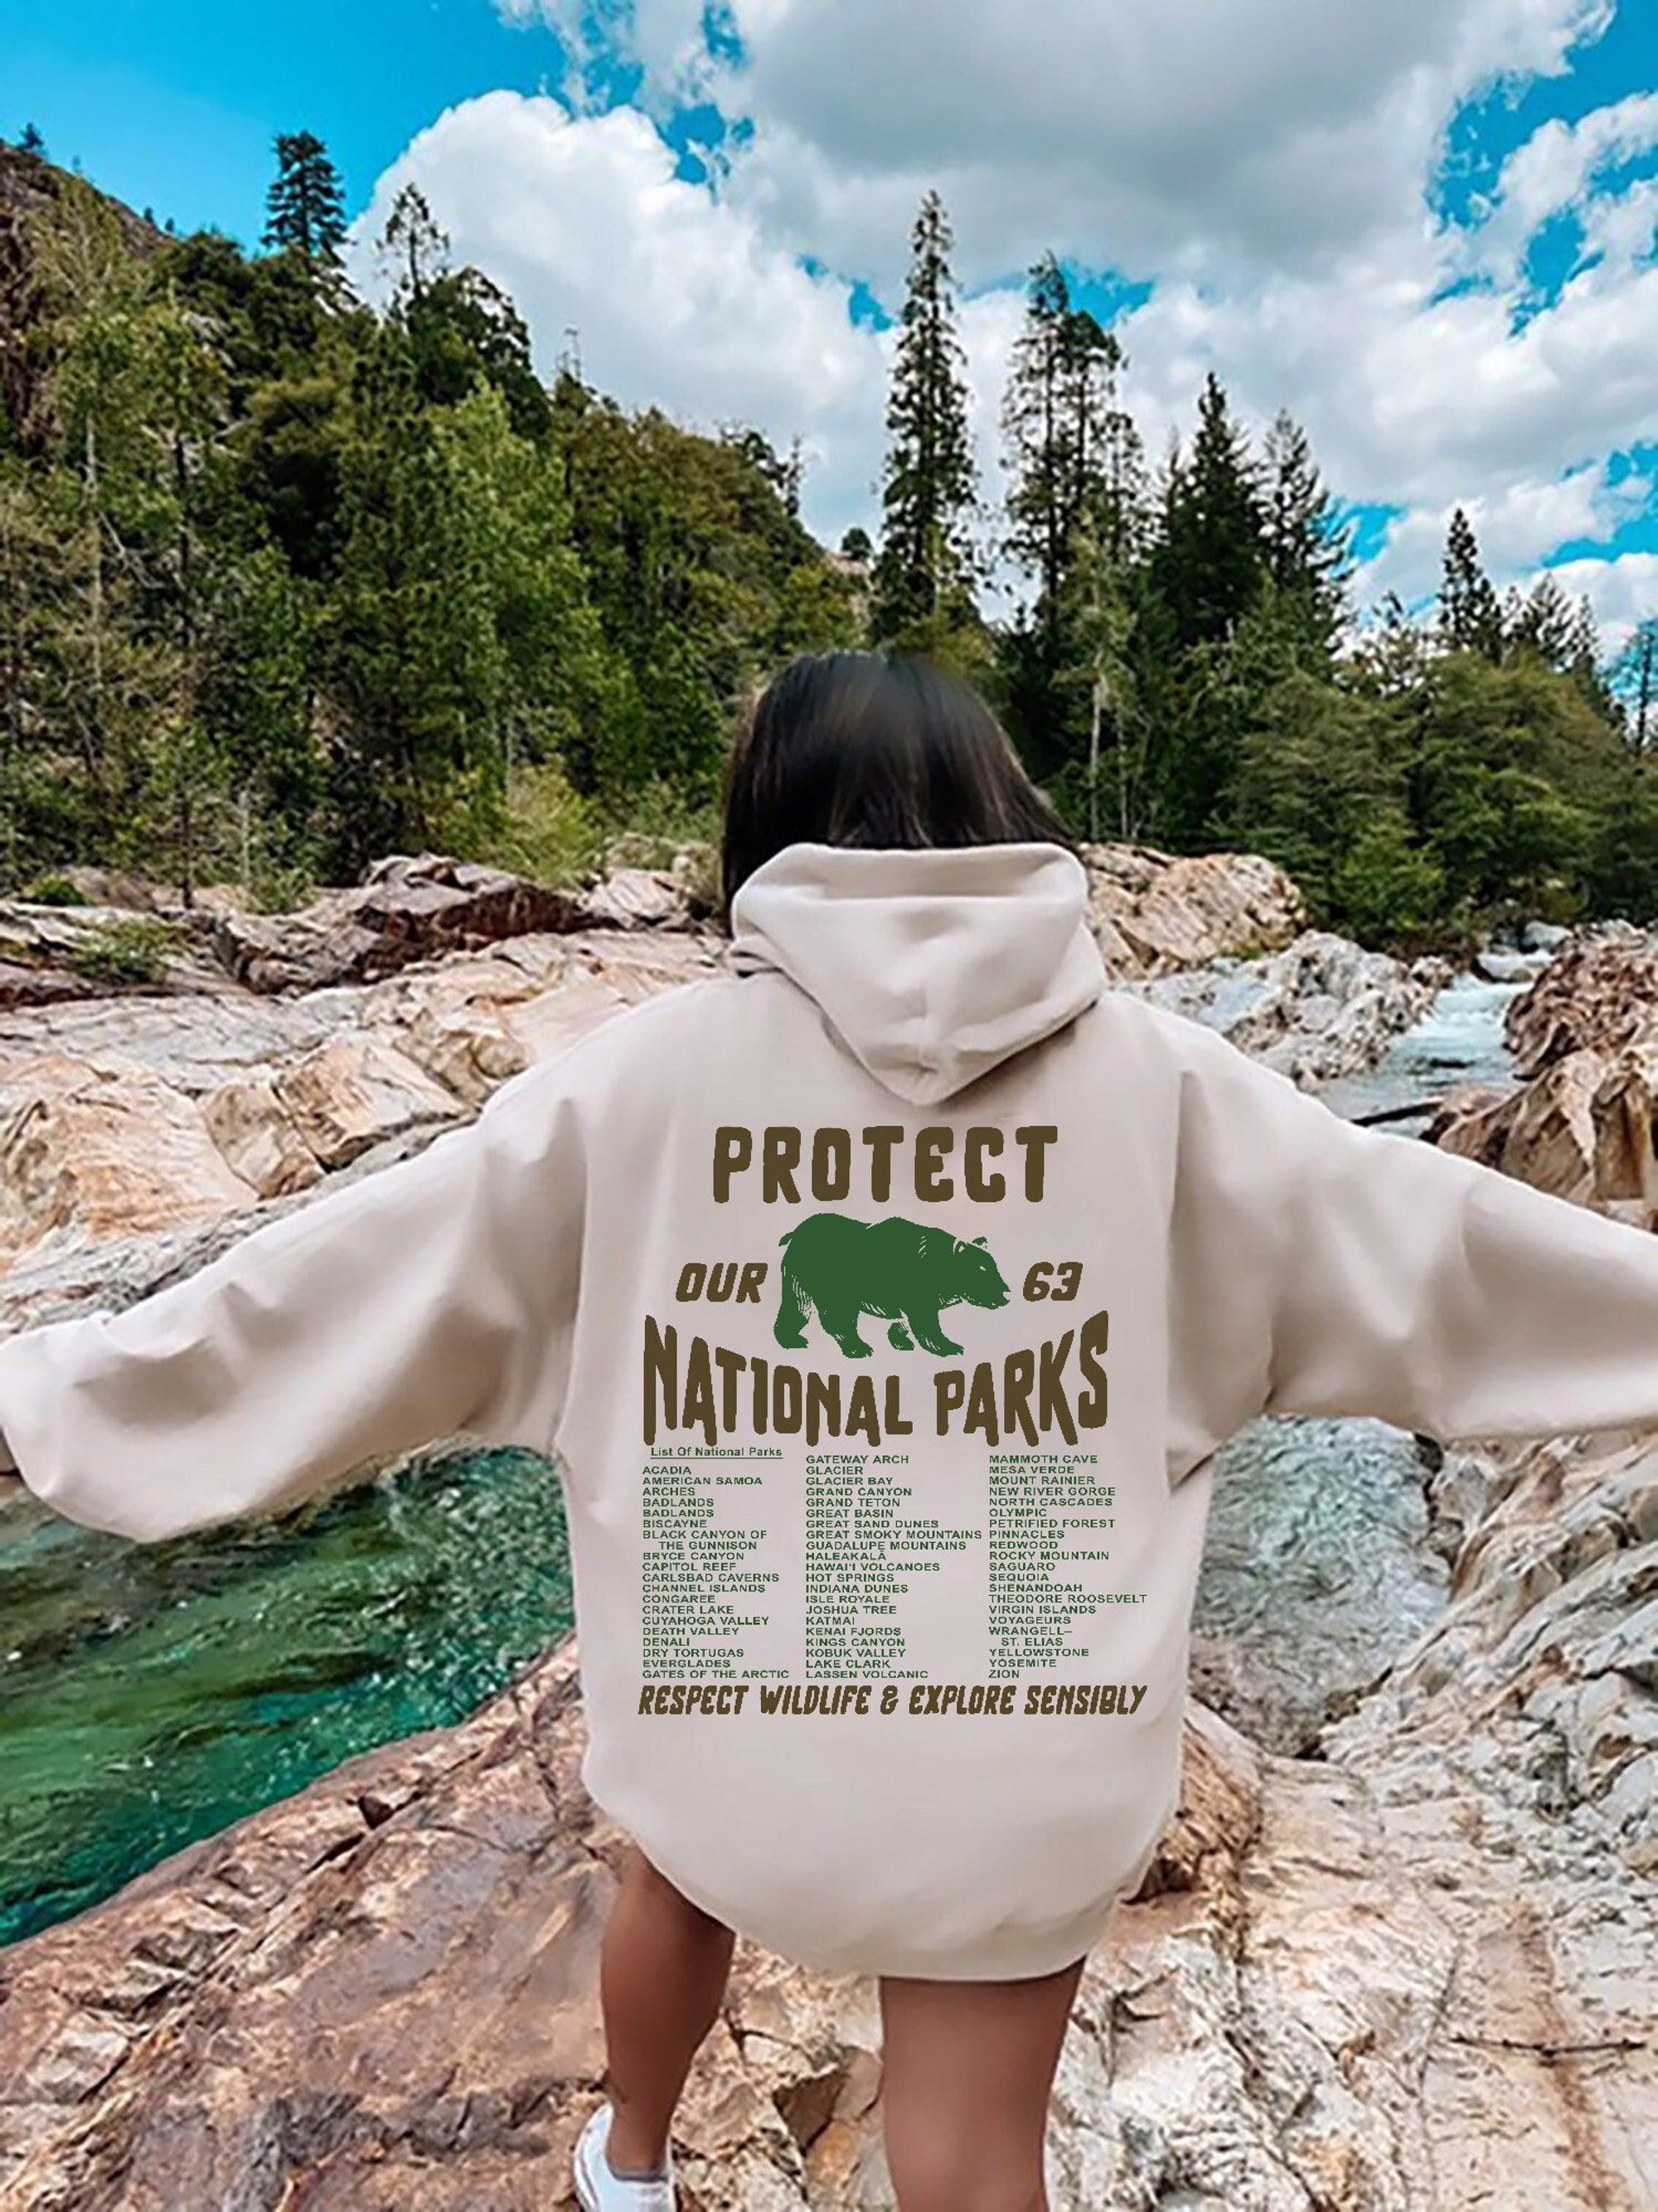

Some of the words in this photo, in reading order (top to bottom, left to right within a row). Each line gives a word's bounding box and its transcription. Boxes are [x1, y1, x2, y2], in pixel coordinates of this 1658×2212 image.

[712, 1125, 1059, 1205] PROTECT
[675, 1262, 768, 1304] OUR
[1022, 1261, 1084, 1302] 63
[643, 1314, 914, 1447] NATIONAL
[933, 1309, 1109, 1448] PARKS
[650, 1447, 674, 1457] List
[677, 1447, 692, 1457] Of
[695, 1447, 744, 1457] National
[749, 1447, 783, 1457] Parks
[805, 1454, 870, 1464] GATEWAY
[871, 1454, 909, 1464] ARCH
[989, 1454, 1059, 1464] MAMMOTH
[1062, 1454, 1098, 1464] CAVE
[642, 1466, 692, 1475] ACADIA
[805, 1465, 864, 1476] GLACIER
[989, 1464, 1026, 1474] MESA
[1030, 1465, 1075, 1474] VERDE
[642, 1476, 711, 1486] AMERICAN
[715, 1476, 763, 1486] SAMOA
[805, 1477, 864, 1487] GLACIER
[867, 1477, 894, 1486] BAY
[989, 1475, 1037, 1486] MOUNT
[1041, 1475, 1096, 1486] RAINIER
[642, 1487, 696, 1496] ARCHES
[805, 1487, 854, 1496] GRAND
[857, 1487, 913, 1496] CANYON
[989, 1487, 1020, 1496] NEW
[1023, 1487, 1064, 1496] RIVER
[1068, 1487, 1116, 1496] GORGE
[642, 1497, 715, 1507] BADLANDS
[805, 1497, 854, 1507] GRAND
[857, 1497, 900, 1507] TETON
[989, 1497, 1035, 1507] NORTH
[1039, 1497, 1113, 1507] CASCADES
[642, 1509, 715, 1518] BADLANDS
[805, 1509, 851, 1519] GREAT
[854, 1509, 894, 1519] BASIN
[989, 1507, 1047, 1517] OLYMPIC
[642, 1519, 708, 1529] BISCAYNE
[805, 1520, 851, 1529] GREAT
[854, 1520, 890, 1529] SAND
[894, 1520, 939, 1529] DUNES
[989, 1519, 1059, 1529] PETRIFIED
[1062, 1519, 1116, 1529] FOREST
[642, 1530, 687, 1540] BLACK
[691, 1530, 745, 1540] CANYON
[750, 1530, 768, 1540] OF
[805, 1530, 851, 1540] GREAT
[854, 1530, 902, 1540] SMOKY
[906, 1530, 982, 1540] MOUNTAINS
[989, 1530, 1065, 1540] PINNACLES
[657, 1540, 685, 1550] THE
[688, 1540, 757, 1550] GUNNISON
[805, 1540, 886, 1550] GUADALUPE
[890, 1540, 967, 1550] MOUNTAINS
[989, 1540, 1059, 1550] REDWOOD
[642, 1551, 686, 1560] BRYCE
[691, 1551, 744, 1560] CANYON
[989, 1550, 1036, 1560] ROCKY
[1040, 1550, 1109, 1560] MOUNTAIN
[642, 1562, 699, 1572] CAPITOL
[702, 1562, 736, 1572] REEF
[860, 1562, 940, 1572] VOLCANOES
[989, 1562, 1056, 1572] SAGUARO
[642, 1573, 714, 1583] CARLSBAD
[718, 1573, 780, 1583] CAVERNS
[805, 1573, 832, 1583] HOT
[836, 1573, 894, 1583] SPRINGS
[988, 1573, 1050, 1583] SEQUOIA
[642, 1584, 705, 1594] CHANNEL
[709, 1584, 766, 1594] ISLANDS
[805, 1584, 861, 1594] INDIANA
[864, 1584, 909, 1594] DUNES
[989, 1583, 1083, 1593] SHENANDOAH
[642, 1594, 716, 1603] CONGAREE
[805, 1595, 835, 1603] ISLE
[838, 1595, 890, 1603] ROYALE
[988, 1594, 1063, 1603] THEODORE
[1068, 1594, 1148, 1603] ROOSEVELT
[642, 1605, 696, 1615] CRATER
[699, 1605, 734, 1615] LAKE
[805, 1605, 860, 1615] JOSHUA
[861, 1605, 897, 1615] TREE
[988, 1605, 1034, 1615] VIRGIN
[1039, 1605, 1098, 1615] ISLANDS
[642, 1616, 716, 1626] CUYAHOGA
[719, 1616, 769, 1626] VALLEY
[805, 1616, 855, 1626] KATMAI
[988, 1616, 1072, 1625] VOYAGEURS
[642, 1627, 686, 1636] DEATH
[689, 1627, 739, 1636] VALLEY
[805, 1627, 846, 1636] KENAI
[851, 1627, 901, 1637] FJORDS
[642, 1637, 690, 1647] DENALI
[805, 1637, 846, 1647] KINGS
[851, 1637, 905, 1647] CANYON
[1001, 1637, 1020, 1647] ST.
[1025, 1637, 1064, 1647] ELIAS
[642, 1648, 669, 1658] DRY
[672, 1648, 744, 1658] TORTUGAS
[805, 1648, 853, 1658] KOBUK
[856, 1648, 907, 1658] VALLEY
[989, 1648, 1089, 1657] YELLOWSTONE
[642, 1659, 731, 1669] EVERGLADES
[805, 1659, 841, 1669] LAKE
[845, 1659, 891, 1669] CLARK
[988, 1658, 1057, 1668] YOSEMITE
[642, 1669, 686, 1679] GATES
[689, 1669, 708, 1679] OF
[710, 1669, 738, 1679] THE
[741, 1669, 790, 1679] ARCTIC
[805, 1670, 858, 1679] LASSEN
[861, 1670, 929, 1679] VOLCANIC
[988, 1669, 1020, 1679] ZION
[638, 1685, 750, 1715] RESPECT
[759, 1685, 873, 1715] WILDLIFE
[880, 1685, 899, 1715] &
[908, 1685, 1017, 1715] EXPLORE
[1023, 1685, 1148, 1715] SENSIBLY
